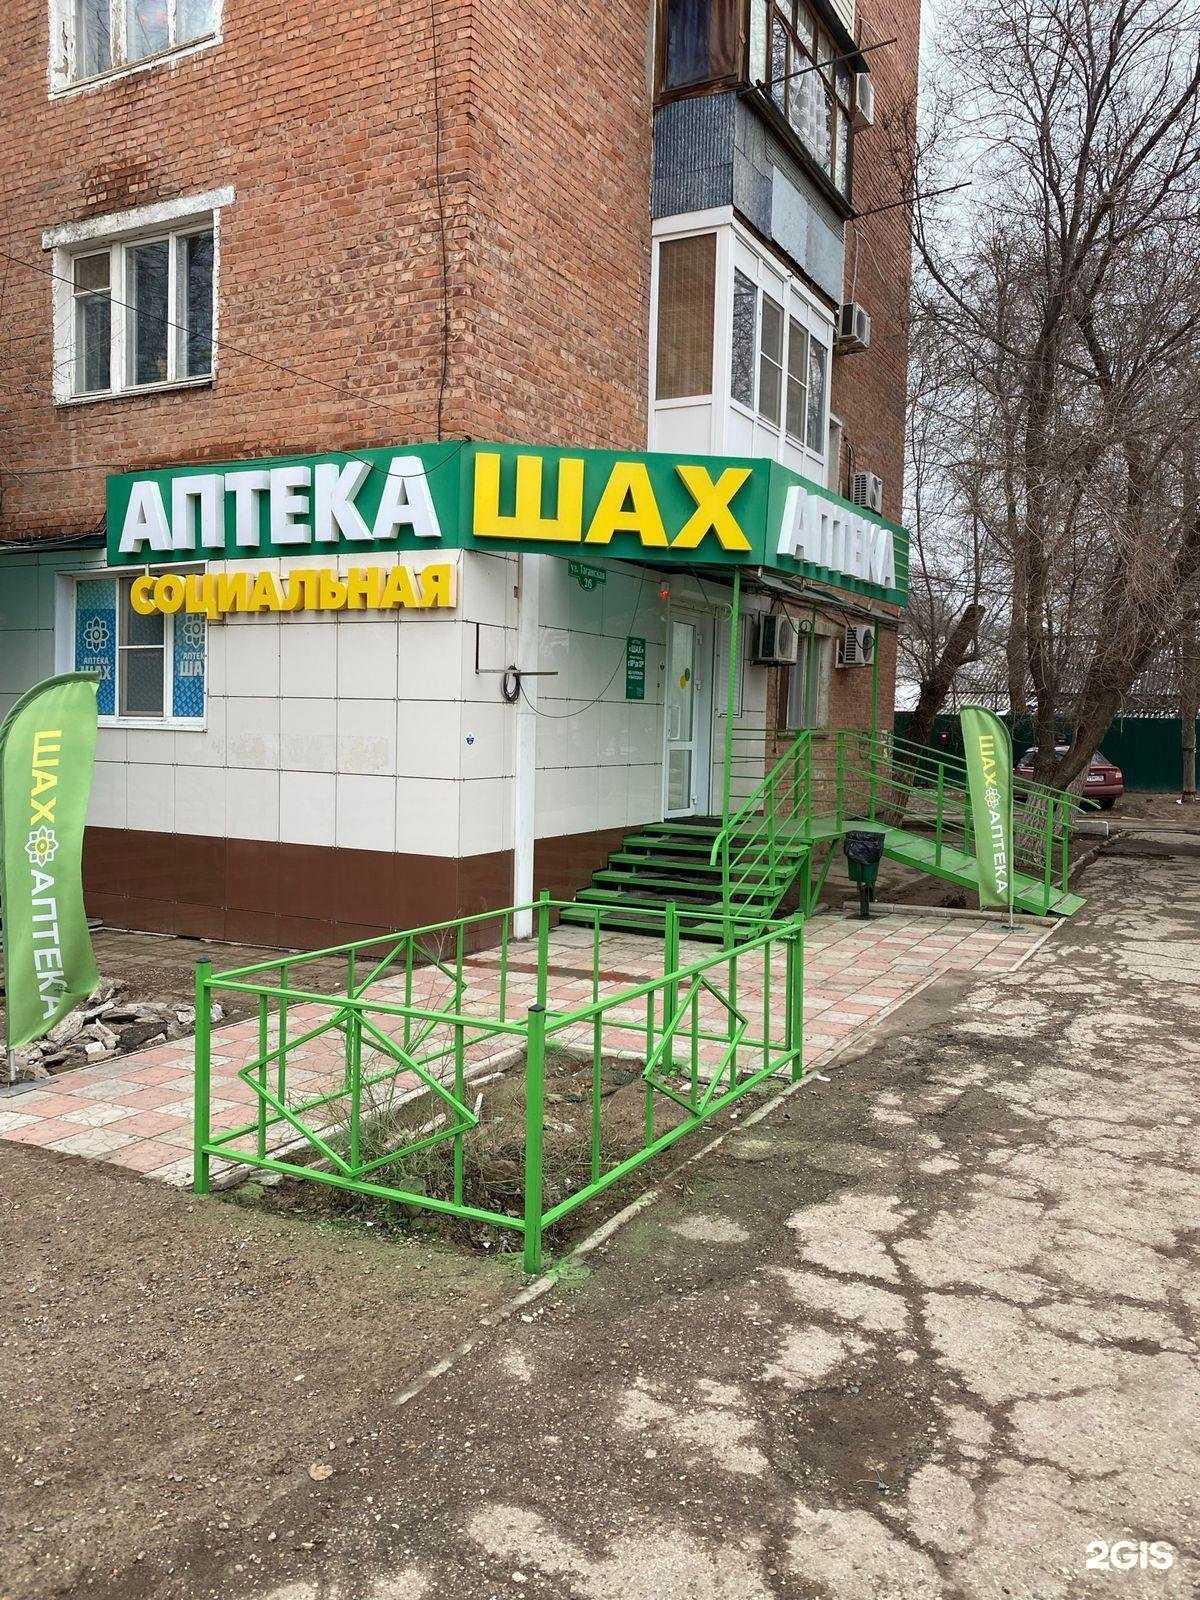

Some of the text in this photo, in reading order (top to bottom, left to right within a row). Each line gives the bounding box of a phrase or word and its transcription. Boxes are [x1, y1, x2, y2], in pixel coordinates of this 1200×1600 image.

[118, 456, 442, 553] АПТЕКА
[473, 452, 753, 551] ШАХ
[776, 485, 897, 590] АПТЕКА
[130, 563, 458, 621] СОЦИАЛЬНАЯ
[83, 656, 110, 665] АПТЕКА
[180, 661, 205, 676] ША
[182, 652, 206, 661] АПТЕК
[30, 729, 62, 826] ШАХ
[979, 735, 997, 787] ШАХ
[988, 808, 1008, 894] АПТЕКА
[31, 867, 68, 1020] АПТЕКА
